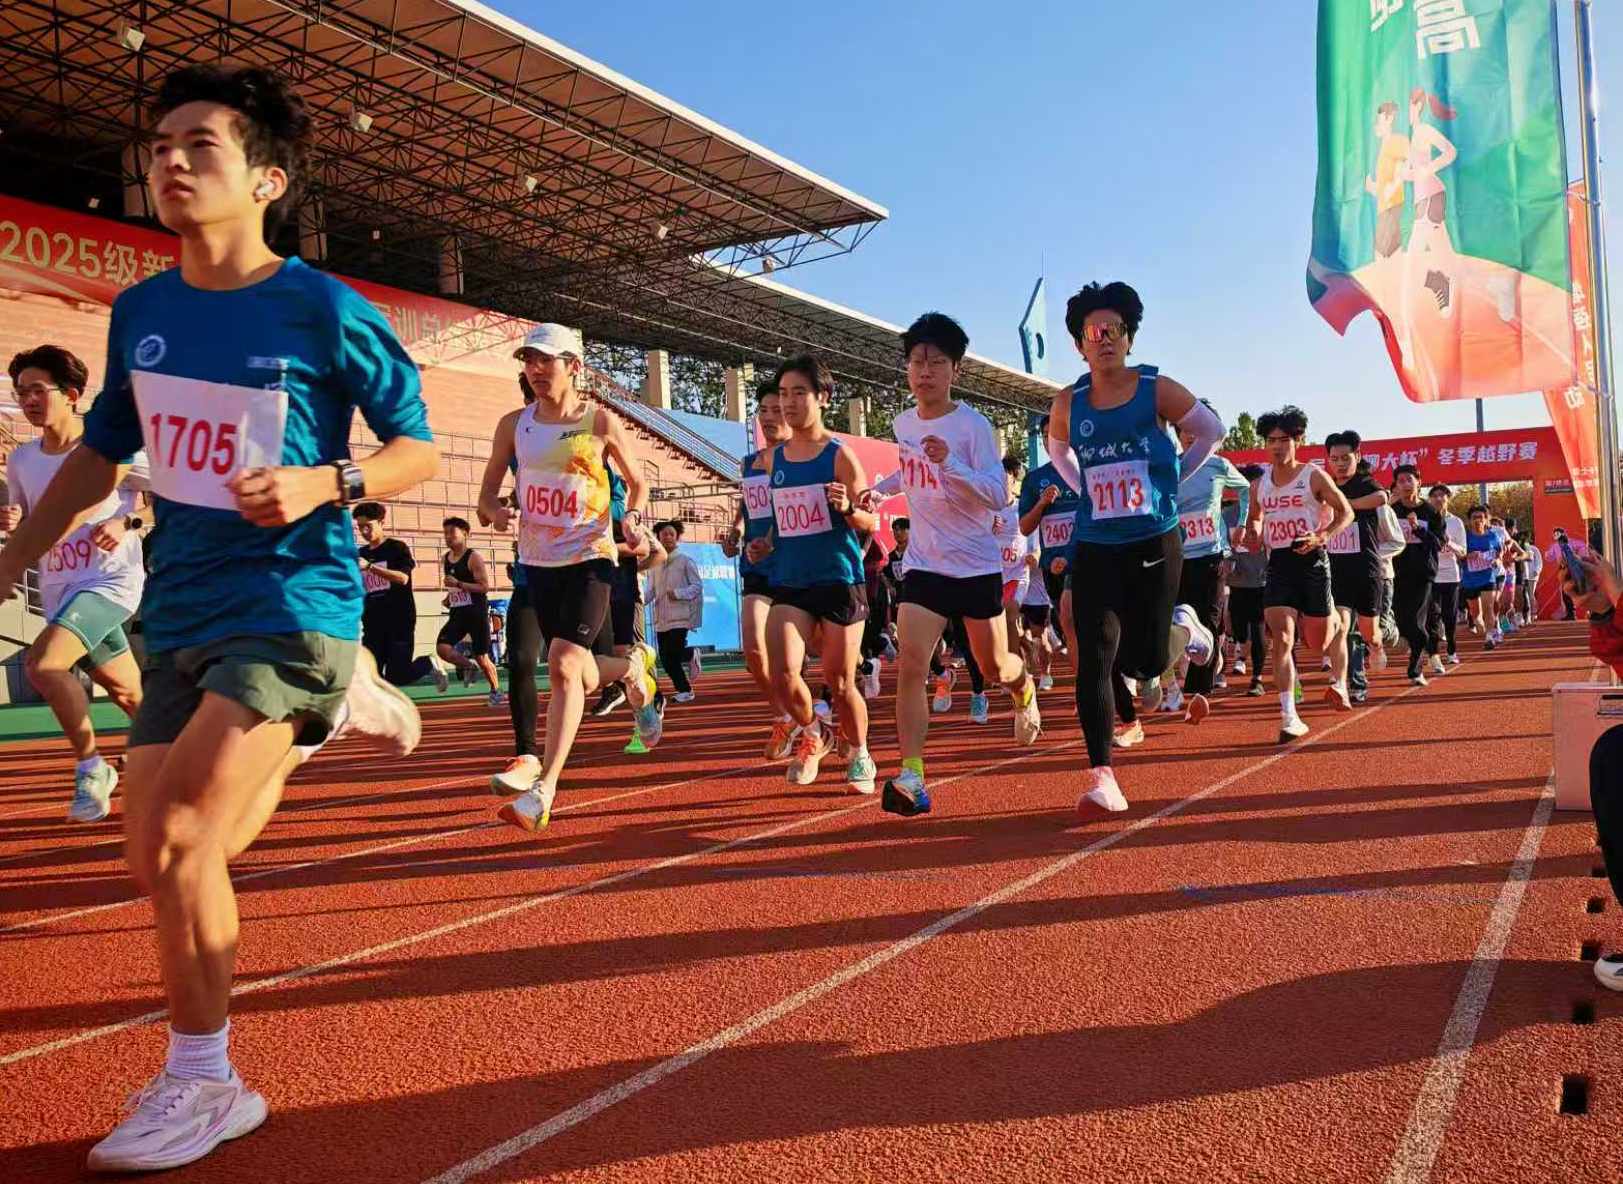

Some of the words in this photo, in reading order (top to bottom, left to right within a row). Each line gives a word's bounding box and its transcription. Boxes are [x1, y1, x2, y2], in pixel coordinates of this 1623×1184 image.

[150, 412, 238, 476] 1705
[526, 484, 578, 519] 0504
[1093, 478, 1145, 512] 2113
[1262, 494, 1303, 509] WSE
[777, 502, 826, 531] 2004
